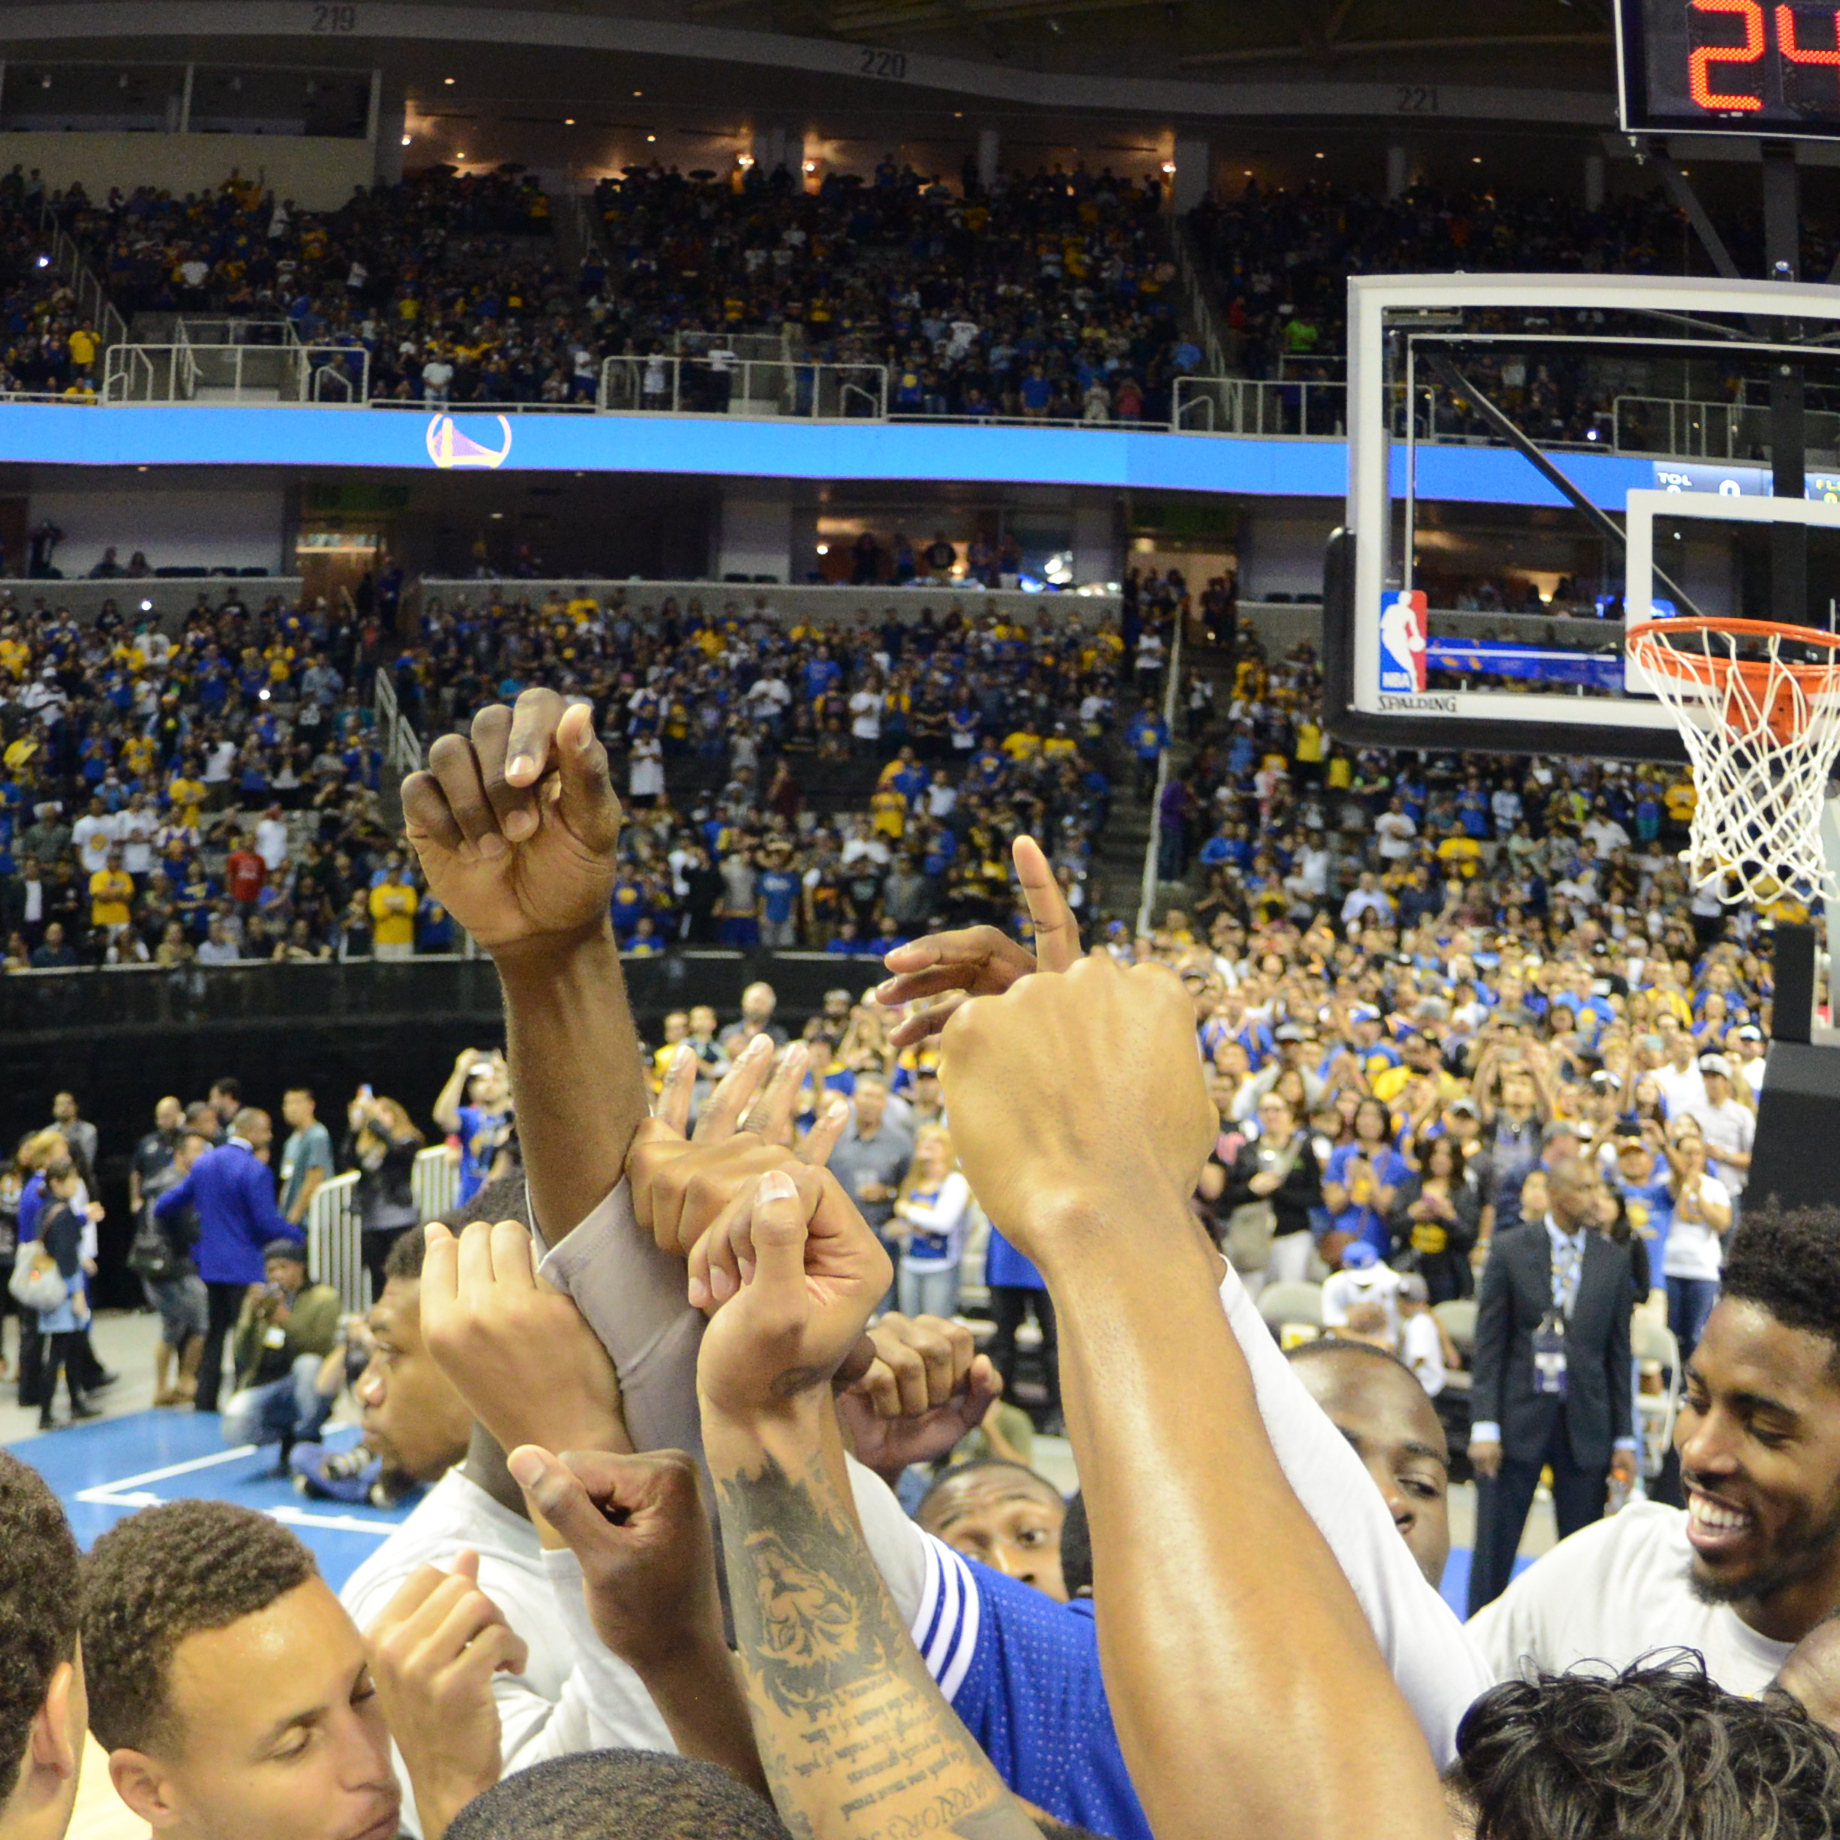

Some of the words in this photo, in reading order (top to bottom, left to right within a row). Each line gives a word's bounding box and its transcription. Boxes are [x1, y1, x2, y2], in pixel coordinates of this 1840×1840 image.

[310, 7, 354, 33] 219
[860, 49, 906, 78] 220
[1395, 87, 1439, 113] 221
[1658, 472, 1692, 487] TOL
[1378, 694, 1457, 713] SPALDING
